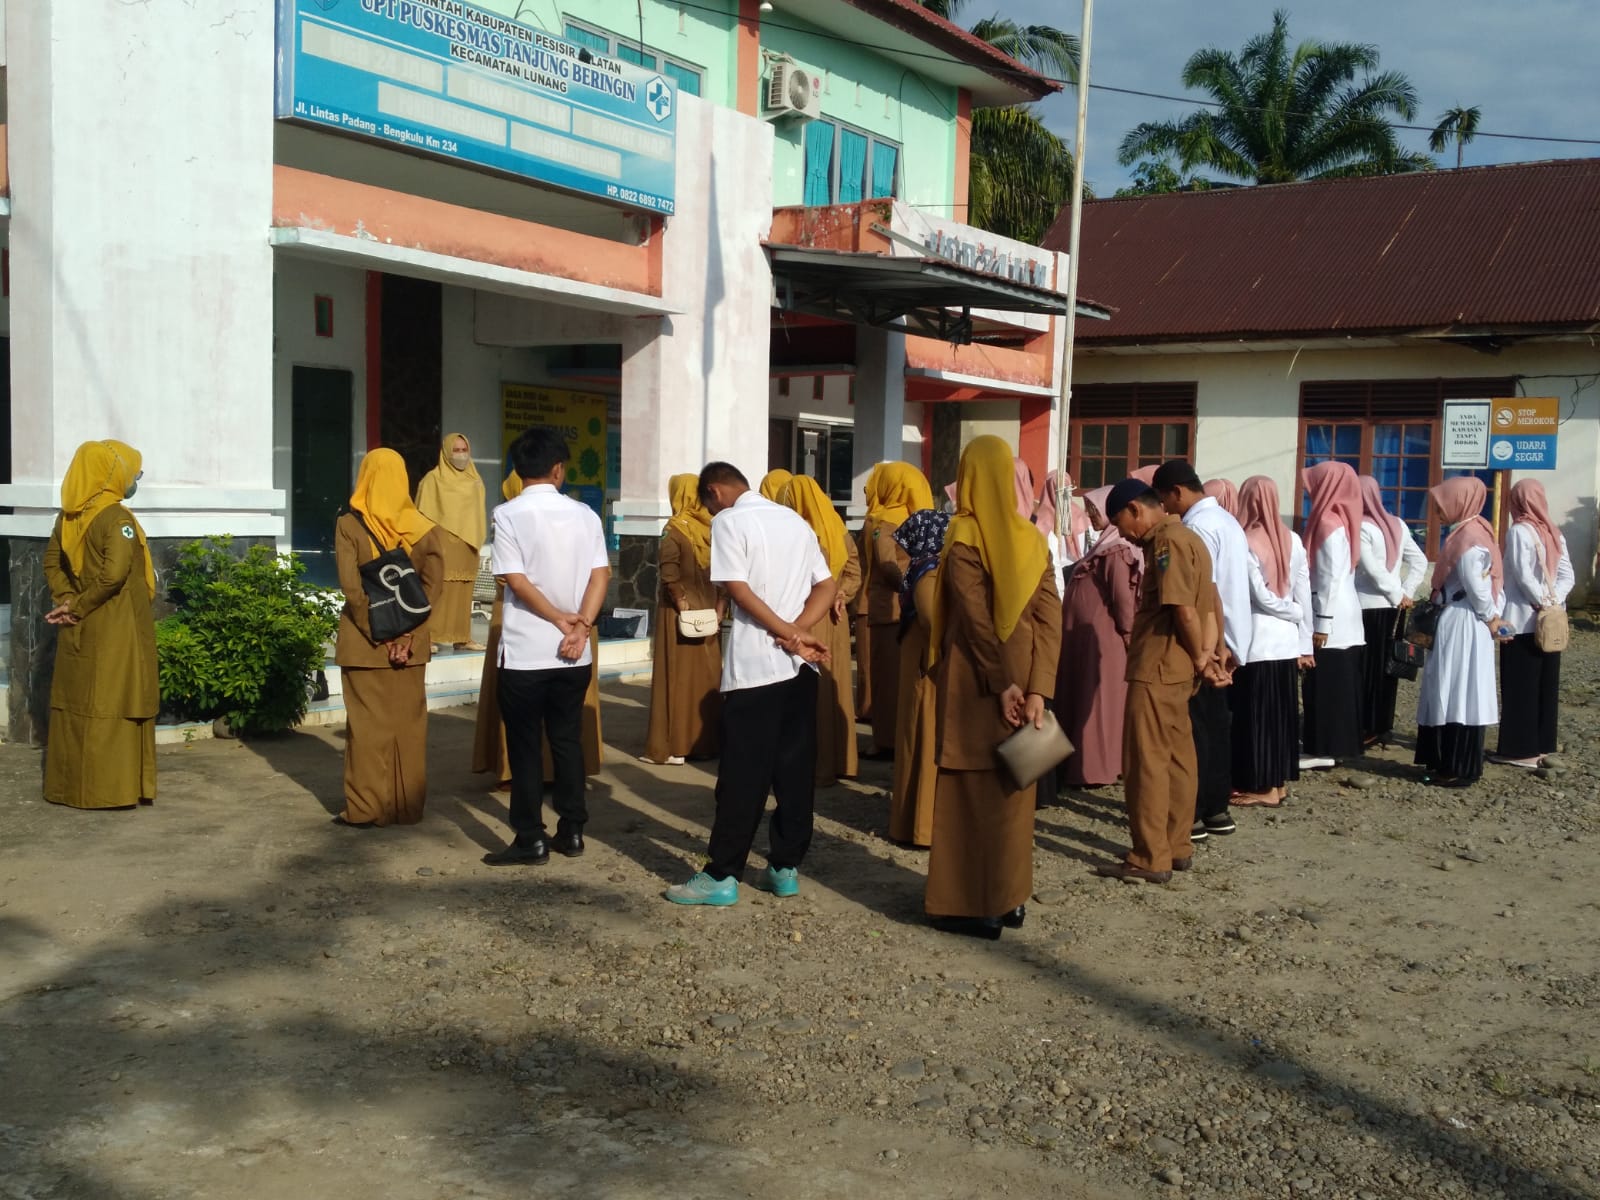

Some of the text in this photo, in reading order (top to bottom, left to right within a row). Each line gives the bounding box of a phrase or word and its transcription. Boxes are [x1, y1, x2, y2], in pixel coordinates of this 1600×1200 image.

[361, 0, 636, 101] UPT PUSKESMAS TANJUNG BERINGIN
[465, 7, 533, 42] KABUPATEN
[535, 33, 576, 58] PESISIR
[579, 49, 622, 75] LATAN
[451, 43, 567, 93] KECAMATAN LUNANG
[295, 101, 308, 115] Jl.
[310, 105, 339, 122] Lintas
[342, 113, 376, 134] Padang
[383, 124, 424, 144] Bengkulu
[425, 135, 440, 149] Km
[442, 140, 458, 153] 234
[607, 184, 674, 212] HP. 0822 6892 7472
[1517, 417, 1556, 425] MEROKOK
[1518, 408, 1537, 417] STOP
[1514, 452, 1544, 462] SEGAR
[1516, 440, 1547, 450] UDARA
